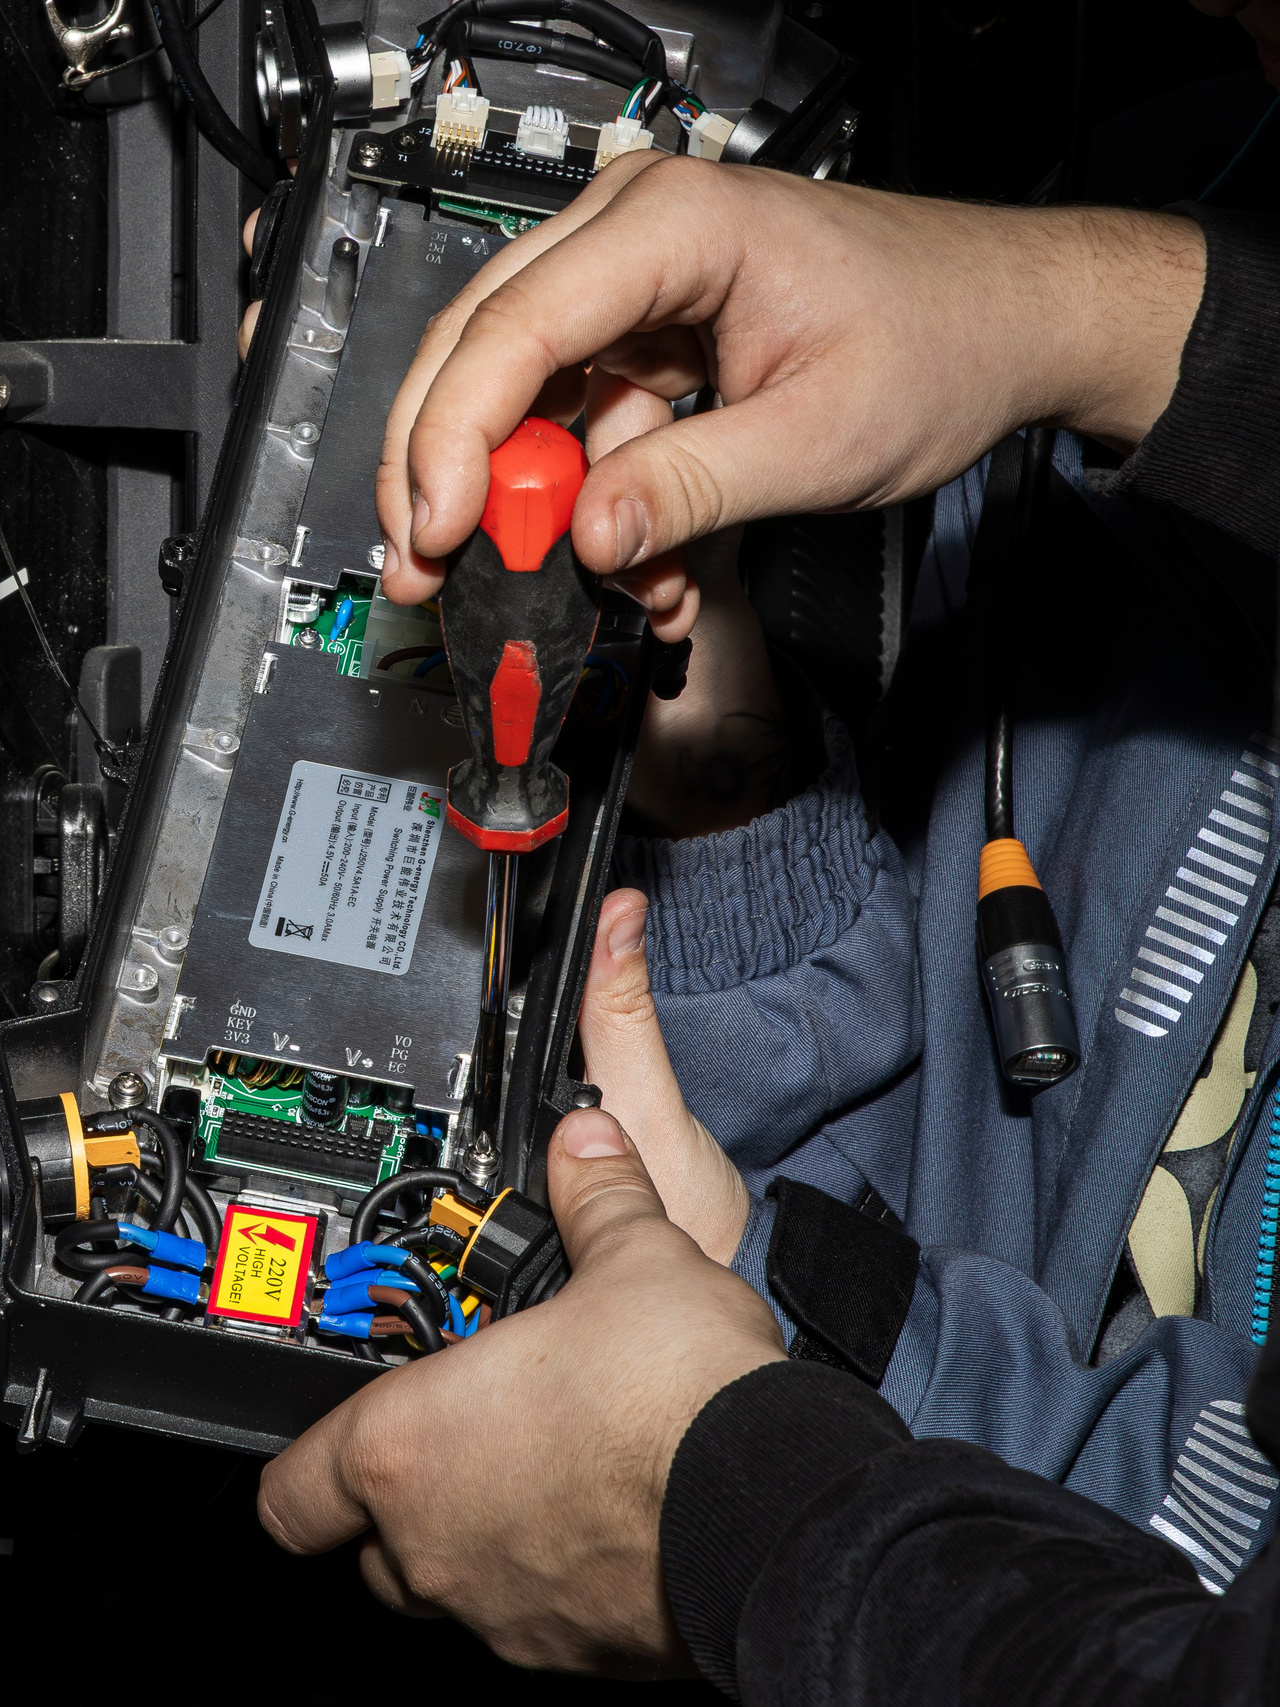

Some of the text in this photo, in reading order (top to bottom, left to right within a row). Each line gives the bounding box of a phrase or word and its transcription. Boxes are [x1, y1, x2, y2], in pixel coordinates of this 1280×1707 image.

[398, 154, 408, 162] T1
[364, 783, 376, 798] 产品
[333, 799, 346, 822] Output
[348, 802, 361, 820] Input
[366, 805, 378, 826] Model
[273, 855, 284, 872] Made
[266, 880, 278, 899] China
[328, 881, 342, 910] 50/60Hz
[364, 826, 402, 950] Switching Power Supply 开关电源
[379, 822, 418, 965] 深圳市巨能伟业技术有限公司
[391, 819, 435, 971] Shenzhen G-energy Technology CO.,Ltd.
[320, 911, 335, 942] 3.0AMax
[230, 1003, 257, 1019] GND
[227, 1017, 254, 1031] KEY
[224, 1029, 250, 1045] 3V3
[395, 1035, 412, 1047] VO
[391, 1048, 409, 1060] PG
[388, 1061, 406, 1073] EC
[251, 1248, 266, 1278] HIGH
[229, 1246, 251, 1304] VOLTAGE!
[264, 1257, 287, 1302] 220V
